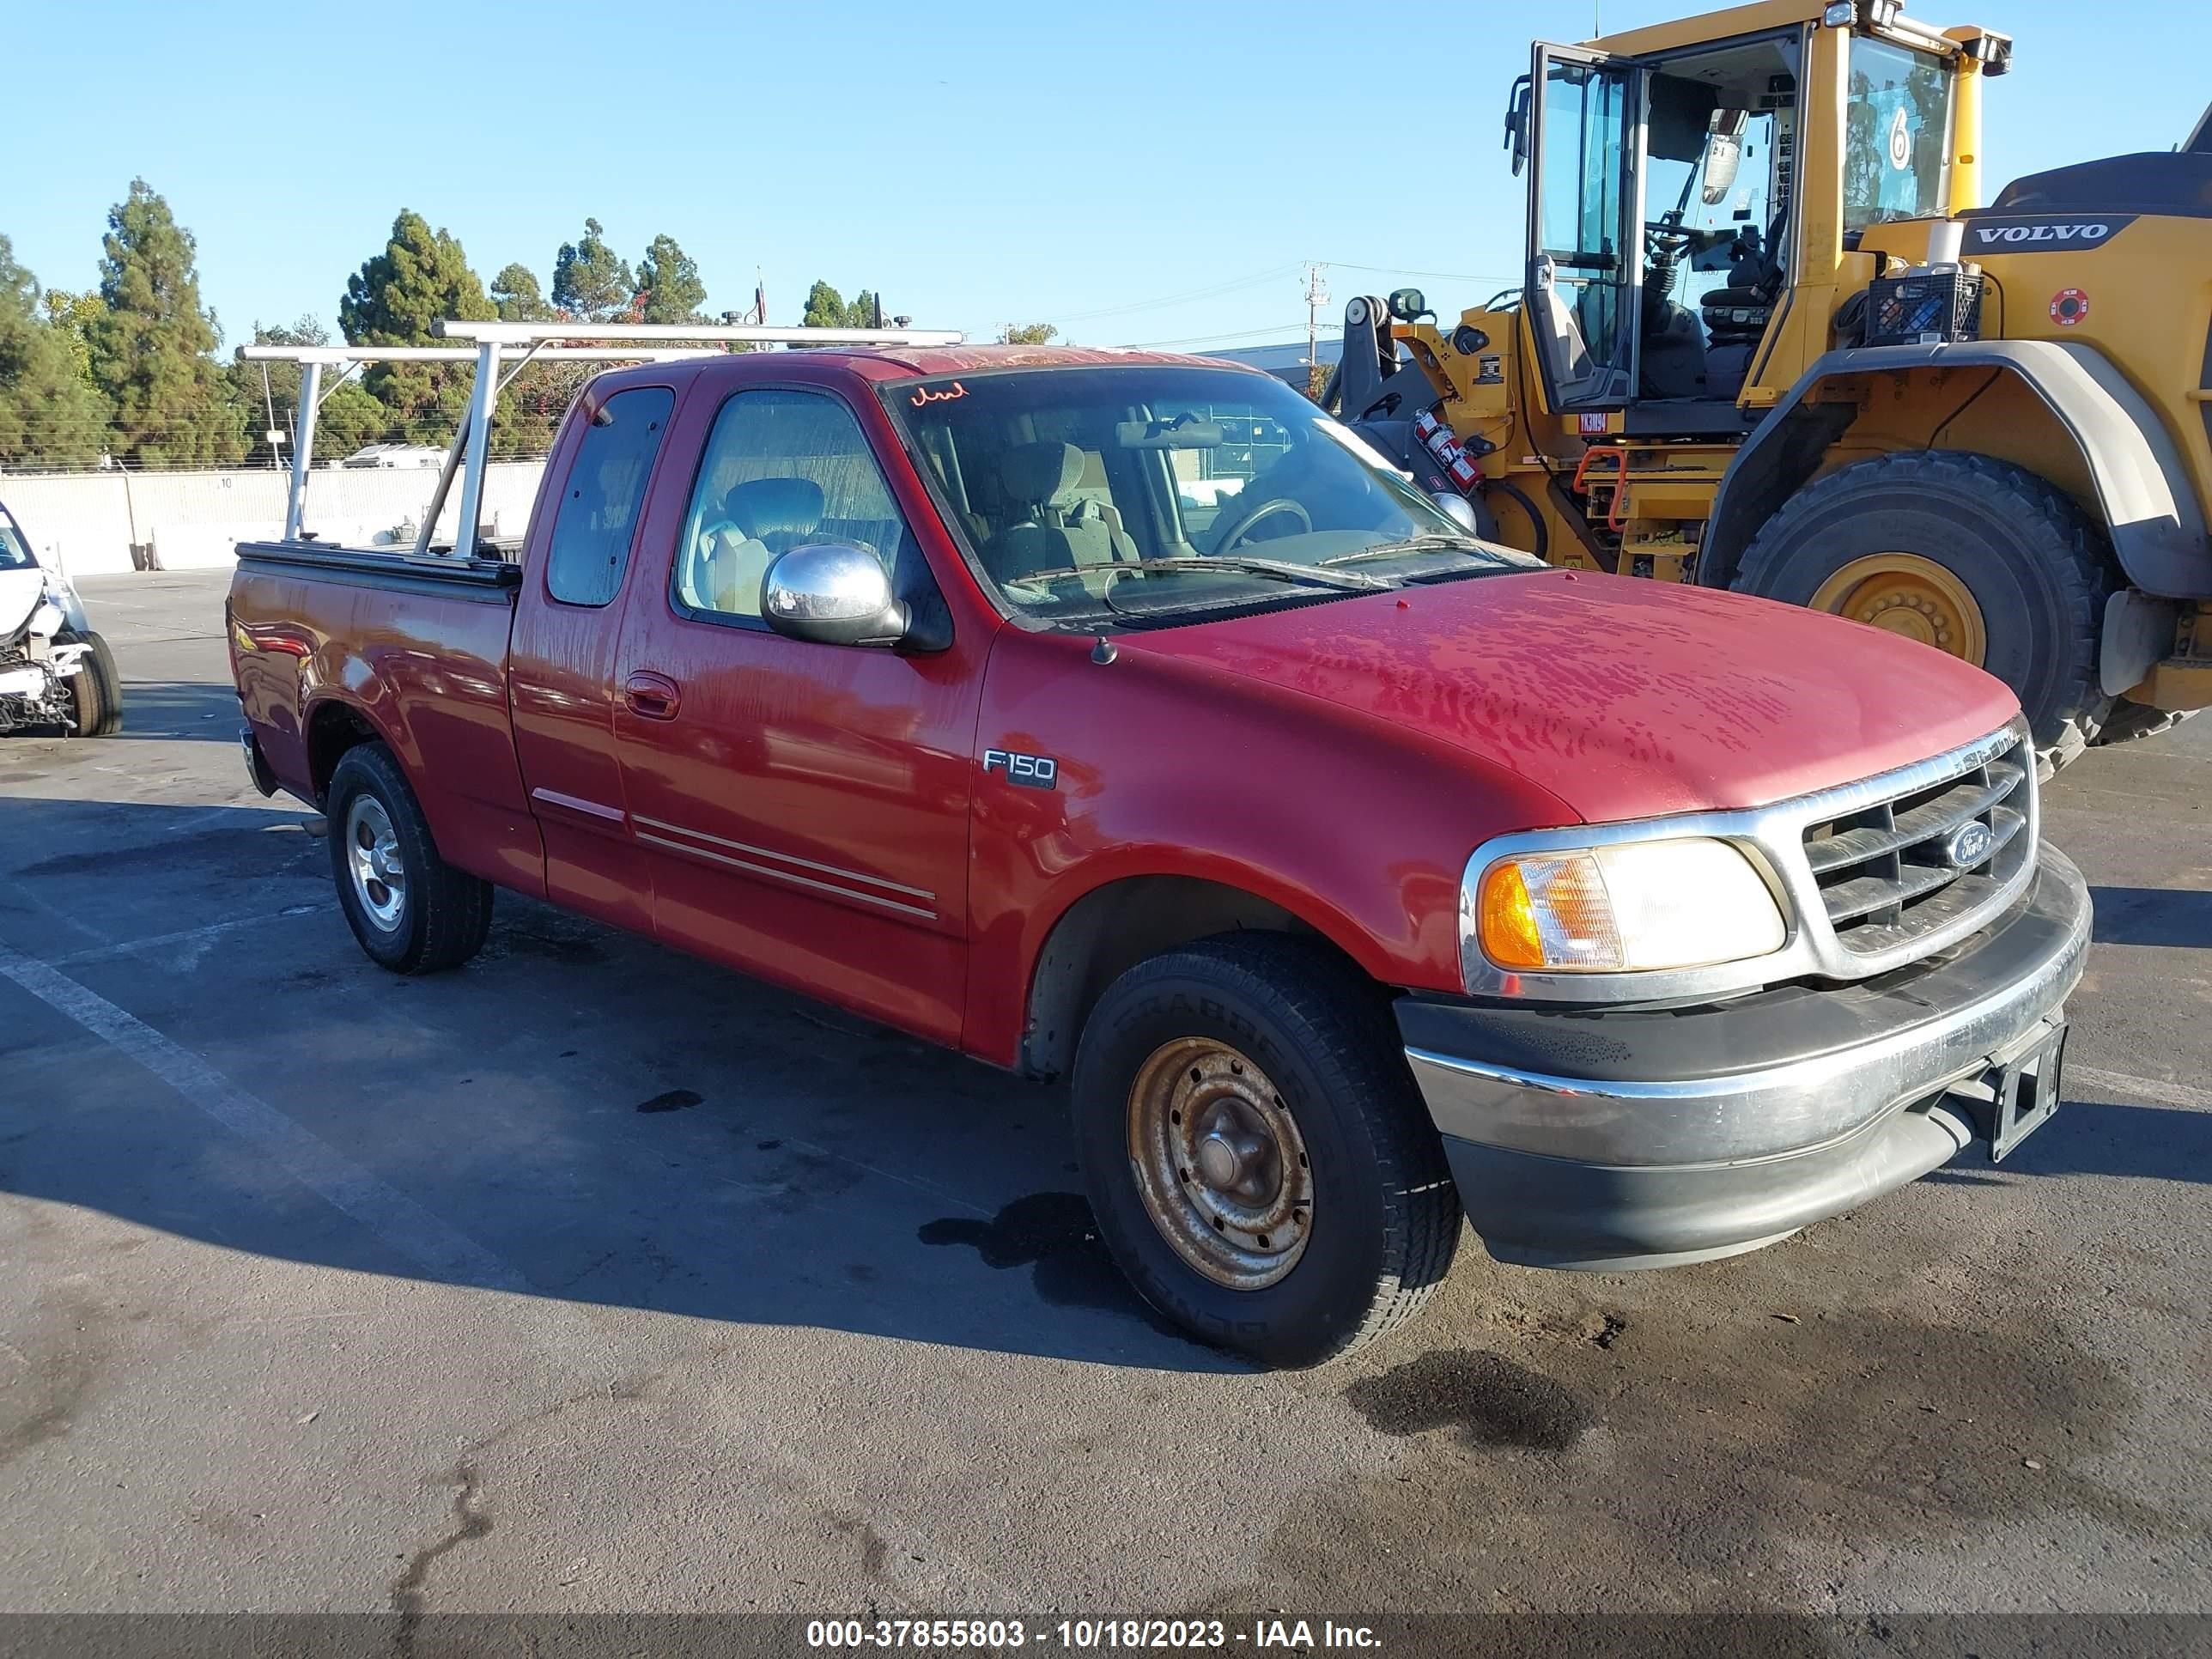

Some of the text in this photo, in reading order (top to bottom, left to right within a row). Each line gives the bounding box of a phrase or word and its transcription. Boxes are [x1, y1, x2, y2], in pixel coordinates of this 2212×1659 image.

[1890, 106, 1910, 170] 6
[1976, 224, 2108, 243] VOLVO
[1438, 443, 1457, 467] 57
[222, 477, 232, 489] 10
[1961, 830, 1984, 860] Ford
